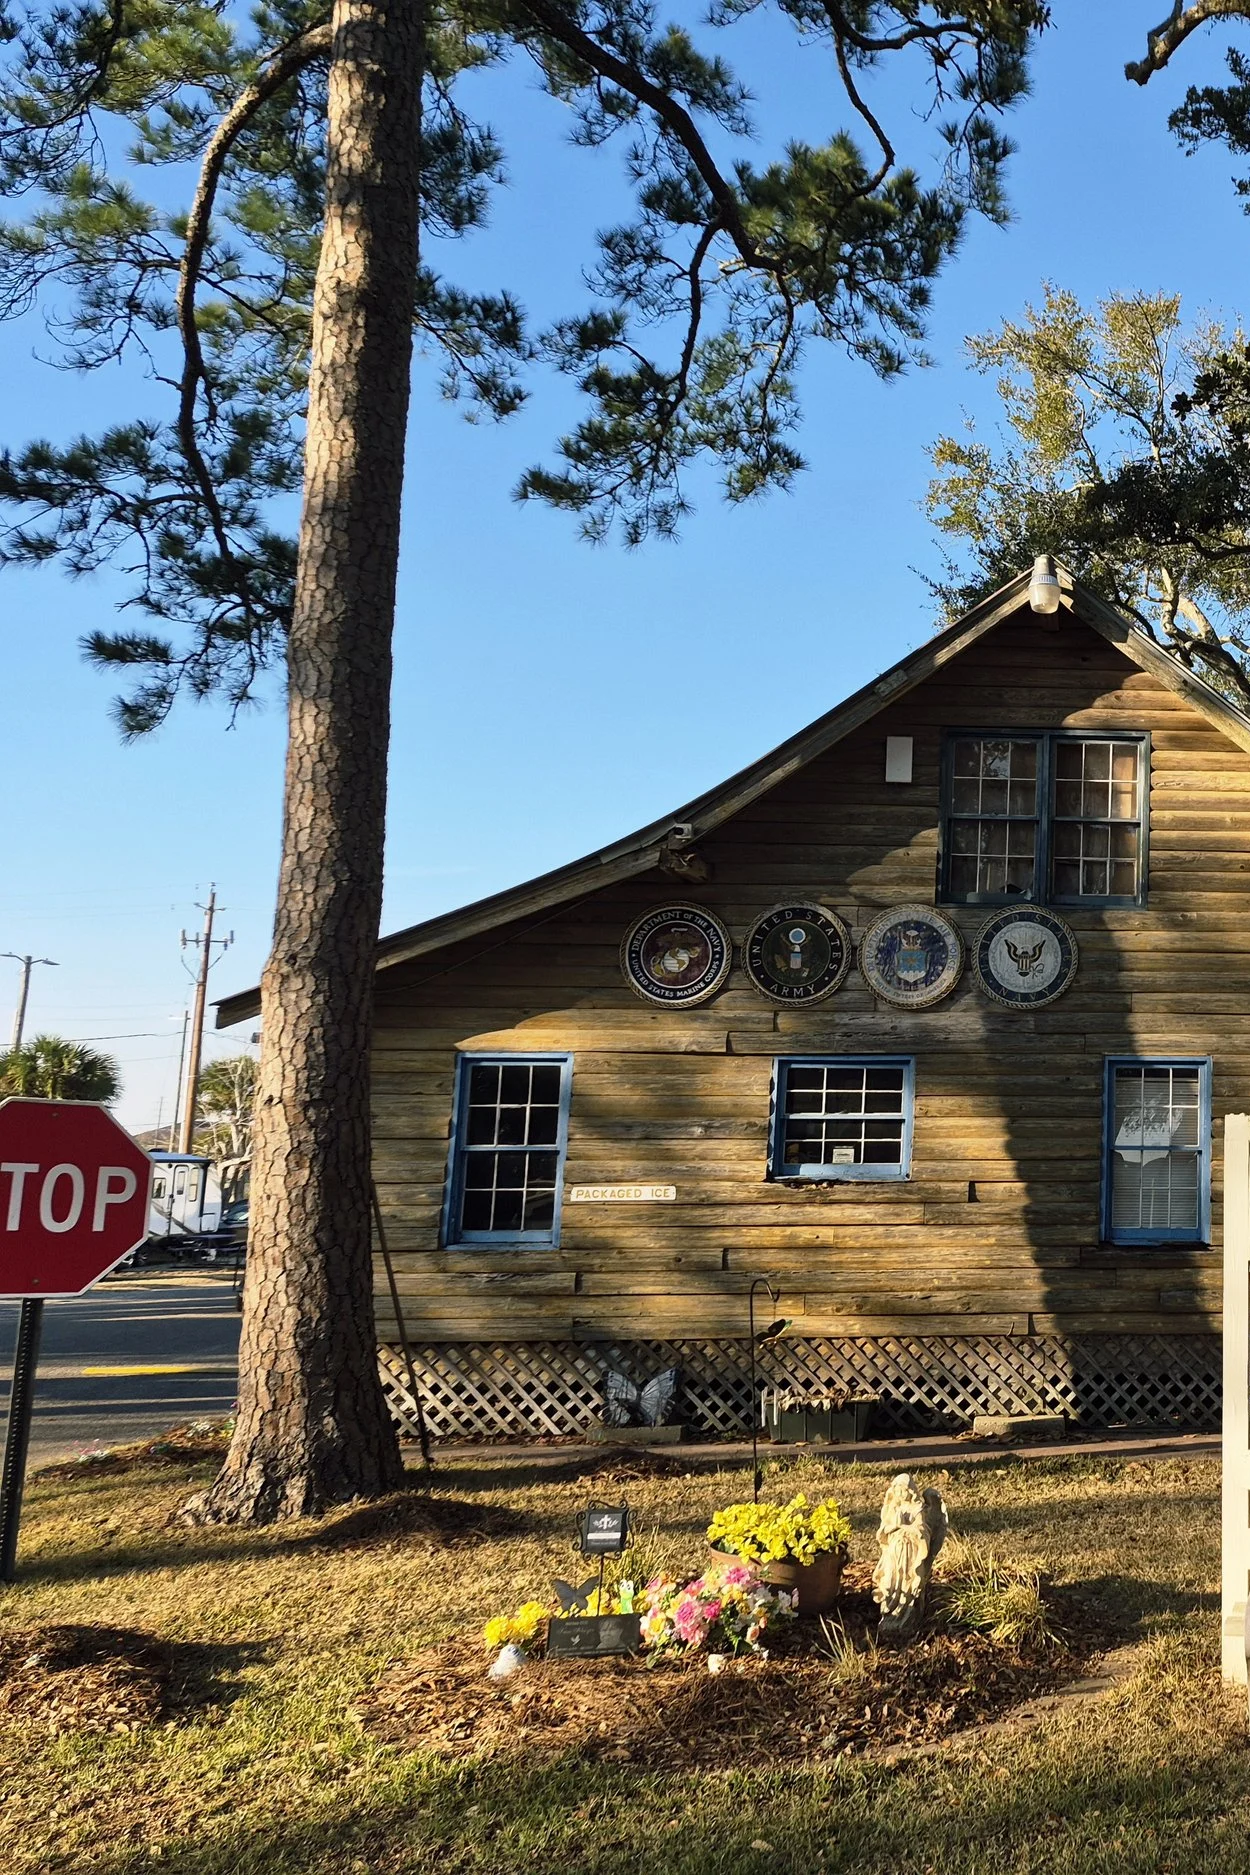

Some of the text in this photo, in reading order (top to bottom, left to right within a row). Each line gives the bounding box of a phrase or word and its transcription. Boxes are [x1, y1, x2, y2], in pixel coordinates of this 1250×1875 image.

[632, 911, 682, 951] DEPARTMENT
[694, 916, 709, 928] THE
[706, 927, 722, 952] NAVY
[752, 910, 842, 971] UNITED STATES
[632, 959, 720, 998] UNITED STATES MARINE CORPS
[770, 983, 816, 997] ARMY
[999, 987, 1051, 1002] NAVY
[0, 1162, 138, 1233] TOP
[575, 1188, 670, 1199] PACKAGED ICE
